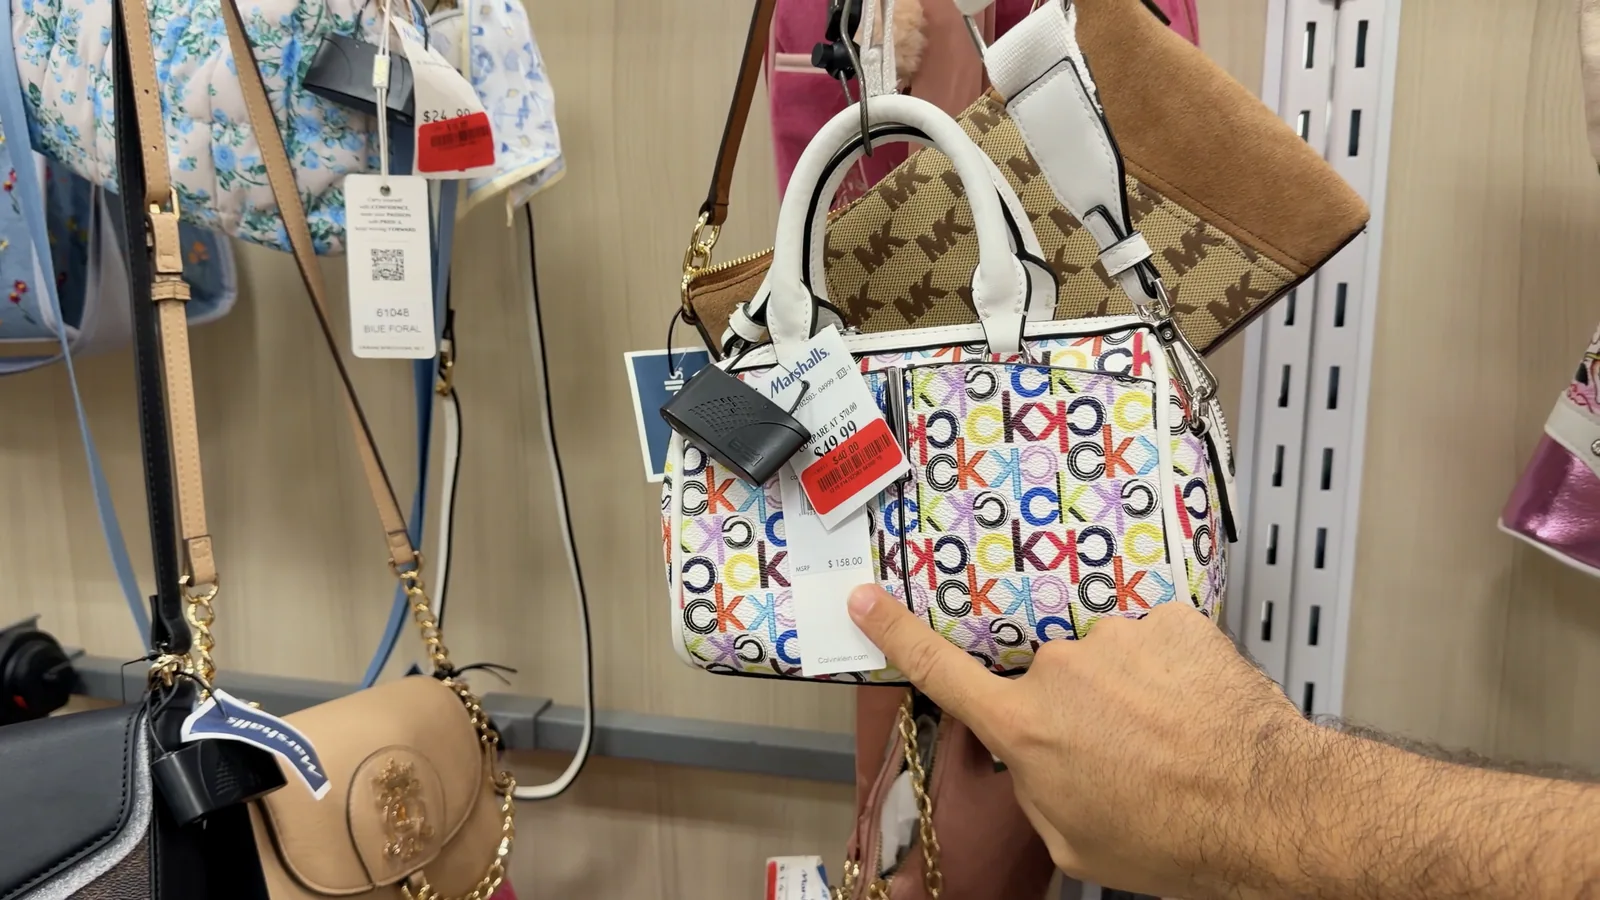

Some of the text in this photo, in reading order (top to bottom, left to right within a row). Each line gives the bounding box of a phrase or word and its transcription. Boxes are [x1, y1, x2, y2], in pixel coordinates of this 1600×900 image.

[799, 420, 830, 453] COMPARE
[830, 416, 839, 429] AT
[835, 556, 863, 567] 158.00
